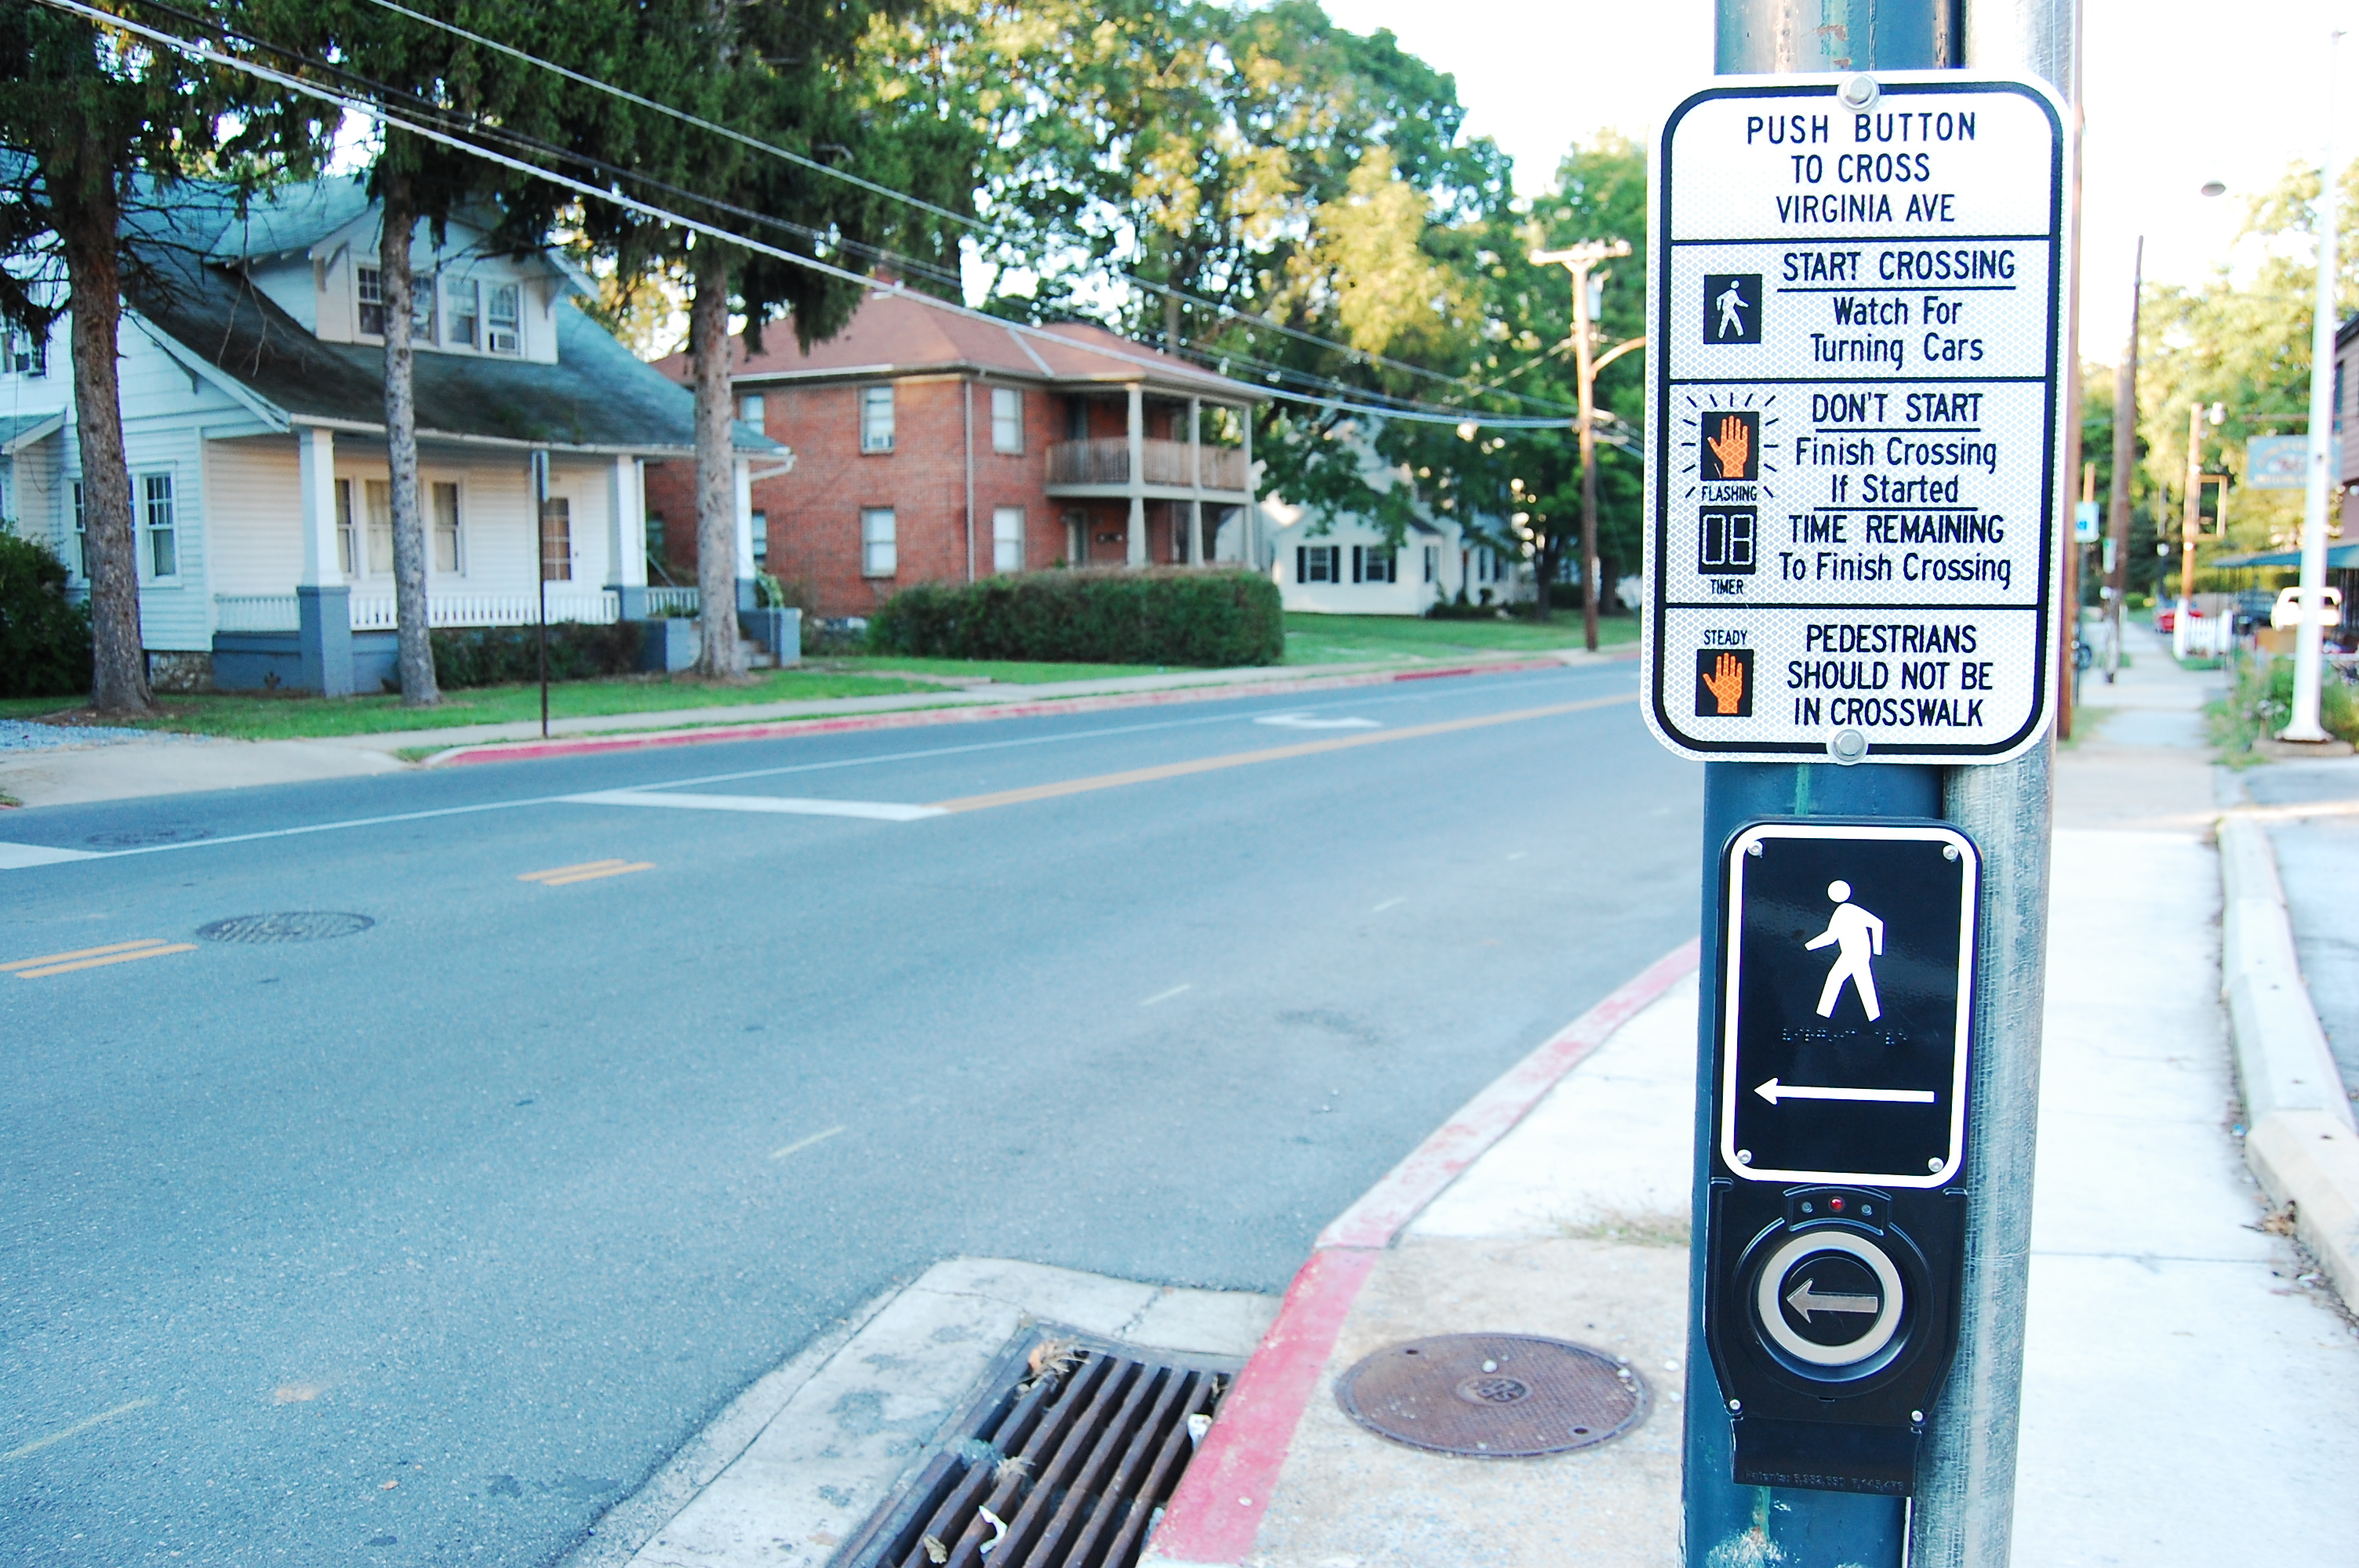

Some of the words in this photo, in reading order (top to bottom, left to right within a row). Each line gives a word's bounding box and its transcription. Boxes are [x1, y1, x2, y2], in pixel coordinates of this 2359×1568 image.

[1747, 114, 1828, 143] PUSH
[1856, 112, 1975, 140] BUTTON
[1791, 154, 1823, 183] TO
[1838, 152, 1930, 183] CROSS
[1776, 194, 1892, 223] VIRGINIA
[1906, 194, 1954, 222] AVE
[1783, 251, 1862, 281] START
[1879, 249, 2015, 280] CROSSING
[1834, 296, 1908, 325] Watch
[1924, 296, 1963, 325] For
[1810, 333, 1903, 371] Turning
[1924, 332, 1983, 361] Cars
[1812, 391, 1888, 423] DON'T
[1906, 393, 1983, 422] START
[1796, 437, 1874, 466] Finish
[1887, 436, 1997, 474] Crossing
[1702, 485, 1757, 502] FLASHING
[1832, 474, 1848, 503] If
[1862, 474, 1959, 503] Started
[1788, 514, 1848, 543] TIME
[1866, 514, 2005, 543] REMAINING
[1779, 551, 1806, 580] To
[1816, 551, 1892, 581] Finish
[1903, 552, 2011, 590] Crossing
[1710, 579, 1744, 595] TIMER
[1703, 629, 1748, 645] STEADY
[1806, 624, 1976, 654] PEDESTRIANS
[1787, 660, 1888, 690] SHOULD
[1901, 661, 1950, 690] NOT
[1961, 662, 1994, 690] BE
[1794, 697, 1821, 726] IN
[1830, 697, 1984, 727] CROSSWALK
